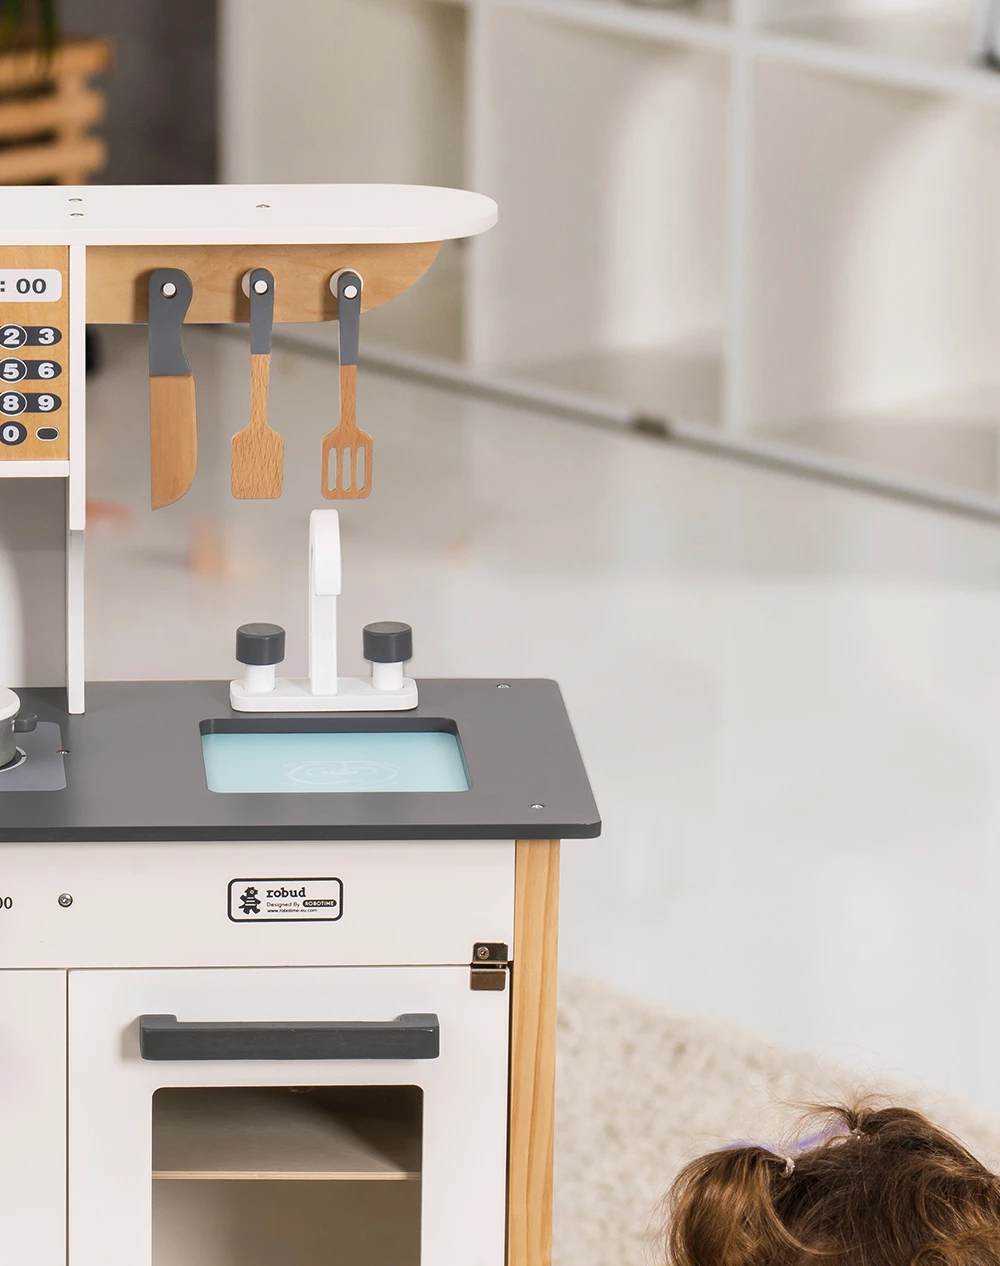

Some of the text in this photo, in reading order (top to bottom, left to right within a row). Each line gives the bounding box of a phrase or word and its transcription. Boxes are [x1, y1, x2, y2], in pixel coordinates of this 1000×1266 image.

[3, 328, 20, 345] 2
[38, 328, 55, 344] 3
[2, 363, 19, 379] 5
[38, 363, 55, 378] 6
[2, 395, 20, 411] 8
[38, 396, 55, 411] 9
[2, 426, 19, 442] 0
[266, 887, 306, 898] robud
